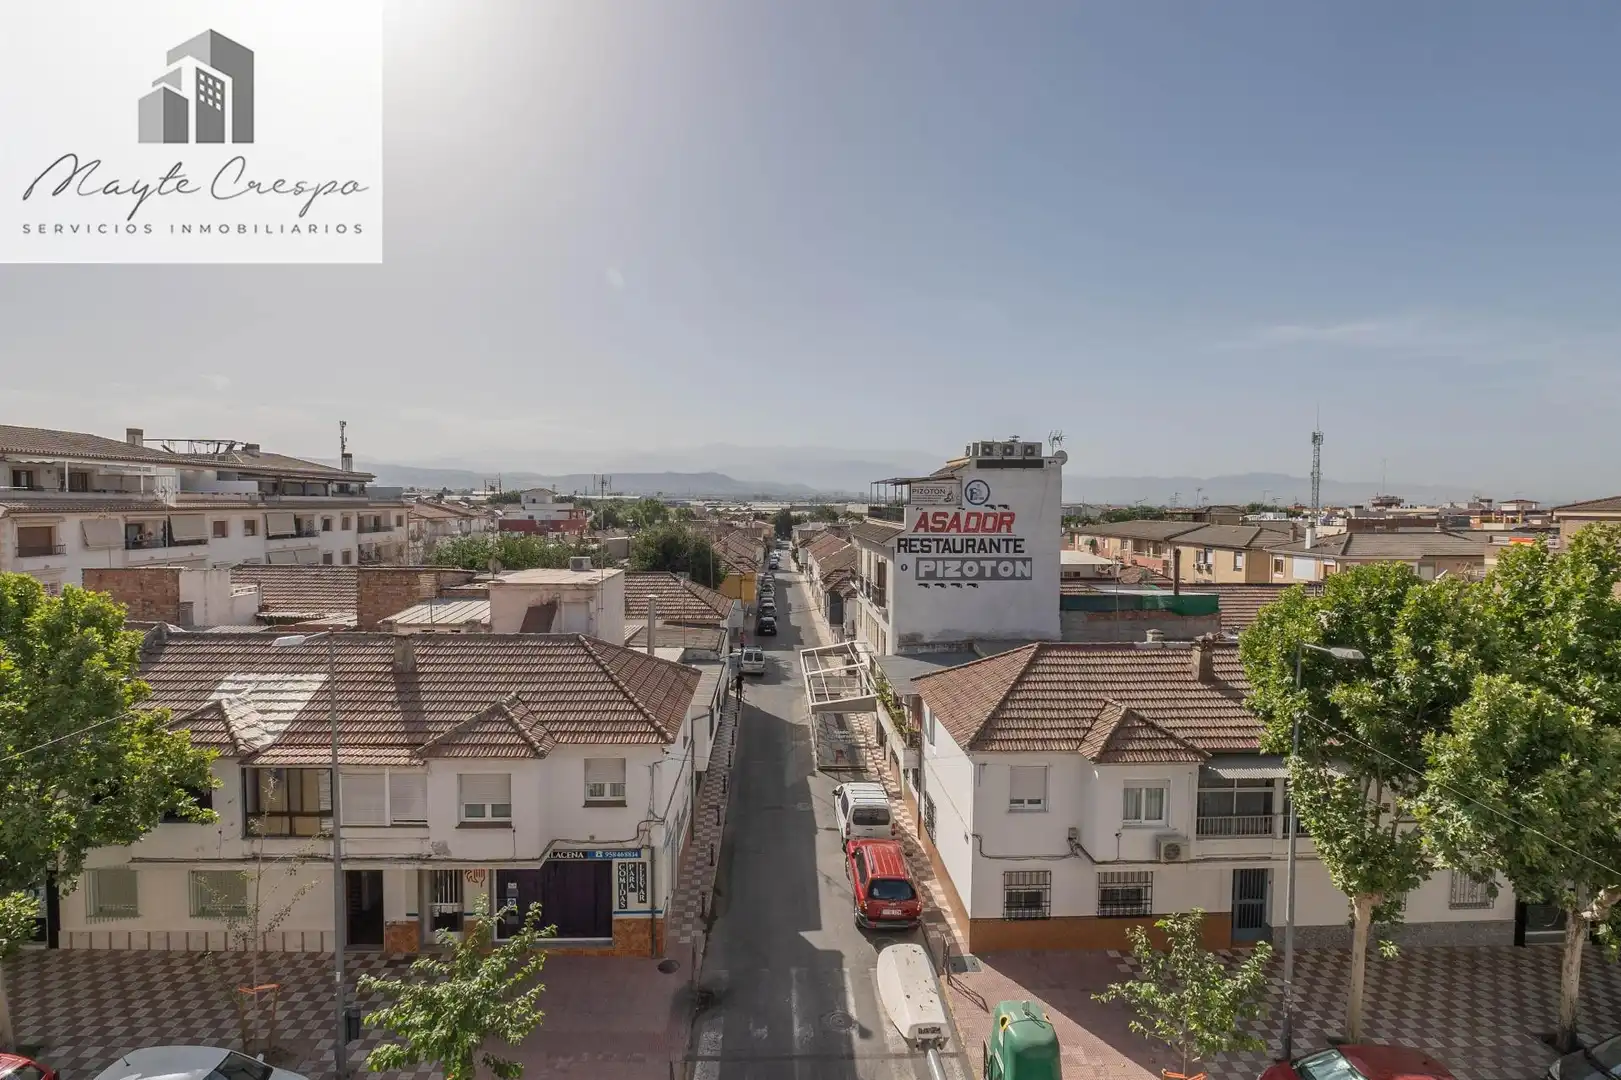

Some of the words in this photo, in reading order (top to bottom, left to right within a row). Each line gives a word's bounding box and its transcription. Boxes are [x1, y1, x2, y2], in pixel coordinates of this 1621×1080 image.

[912, 511, 1016, 534] ASADOR
[897, 538, 1025, 554] RESTAURANTE
[918, 560, 1031, 578] PIZOTON
[618, 863, 627, 908] COMIDAS
[628, 863, 636, 889] PARA
[638, 863, 646, 902] LLEVAR
